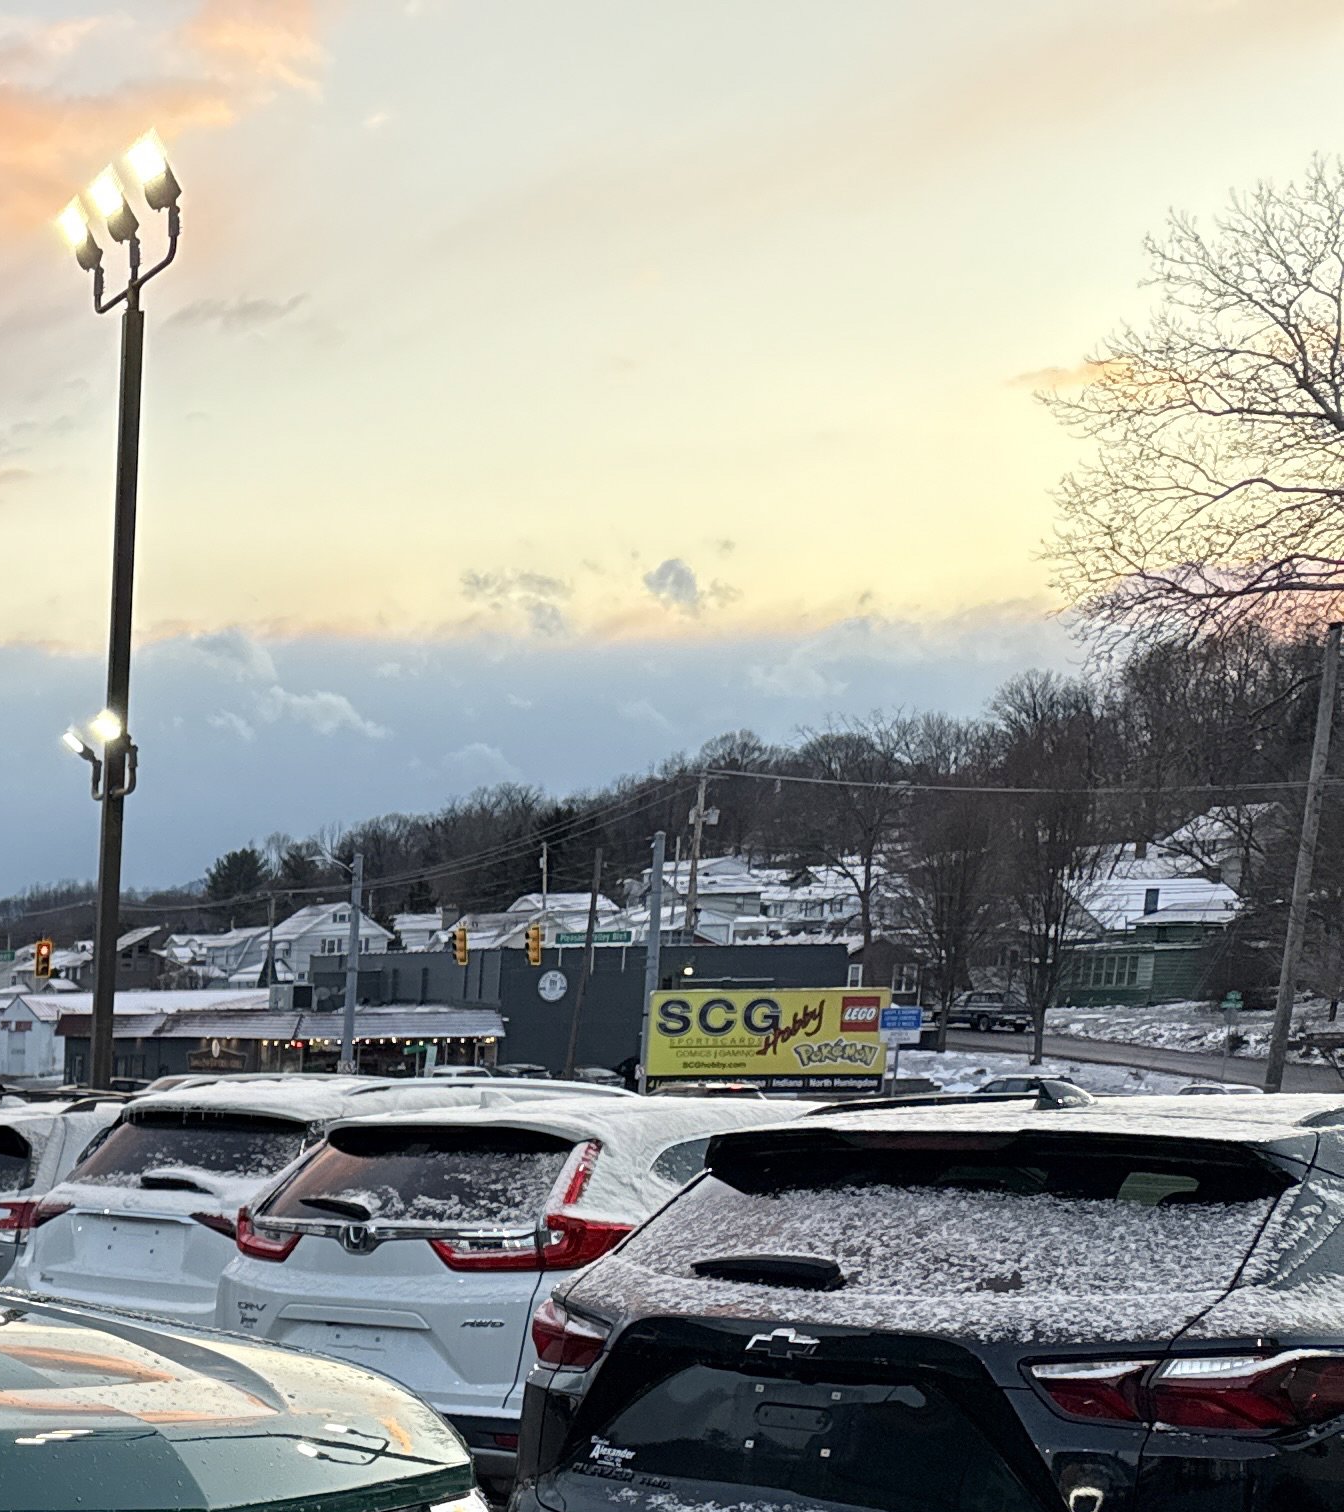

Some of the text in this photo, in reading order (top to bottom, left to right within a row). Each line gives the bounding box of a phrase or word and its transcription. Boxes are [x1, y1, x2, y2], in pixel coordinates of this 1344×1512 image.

[559, 933, 586, 943] Pleasan
[656, 998, 783, 1037] SCG
[843, 1006, 878, 1022] LEGO
[756, 999, 826, 1056] Hobby
[809, 1078, 832, 1088] North
[589, 1444, 637, 1460] Alexander
